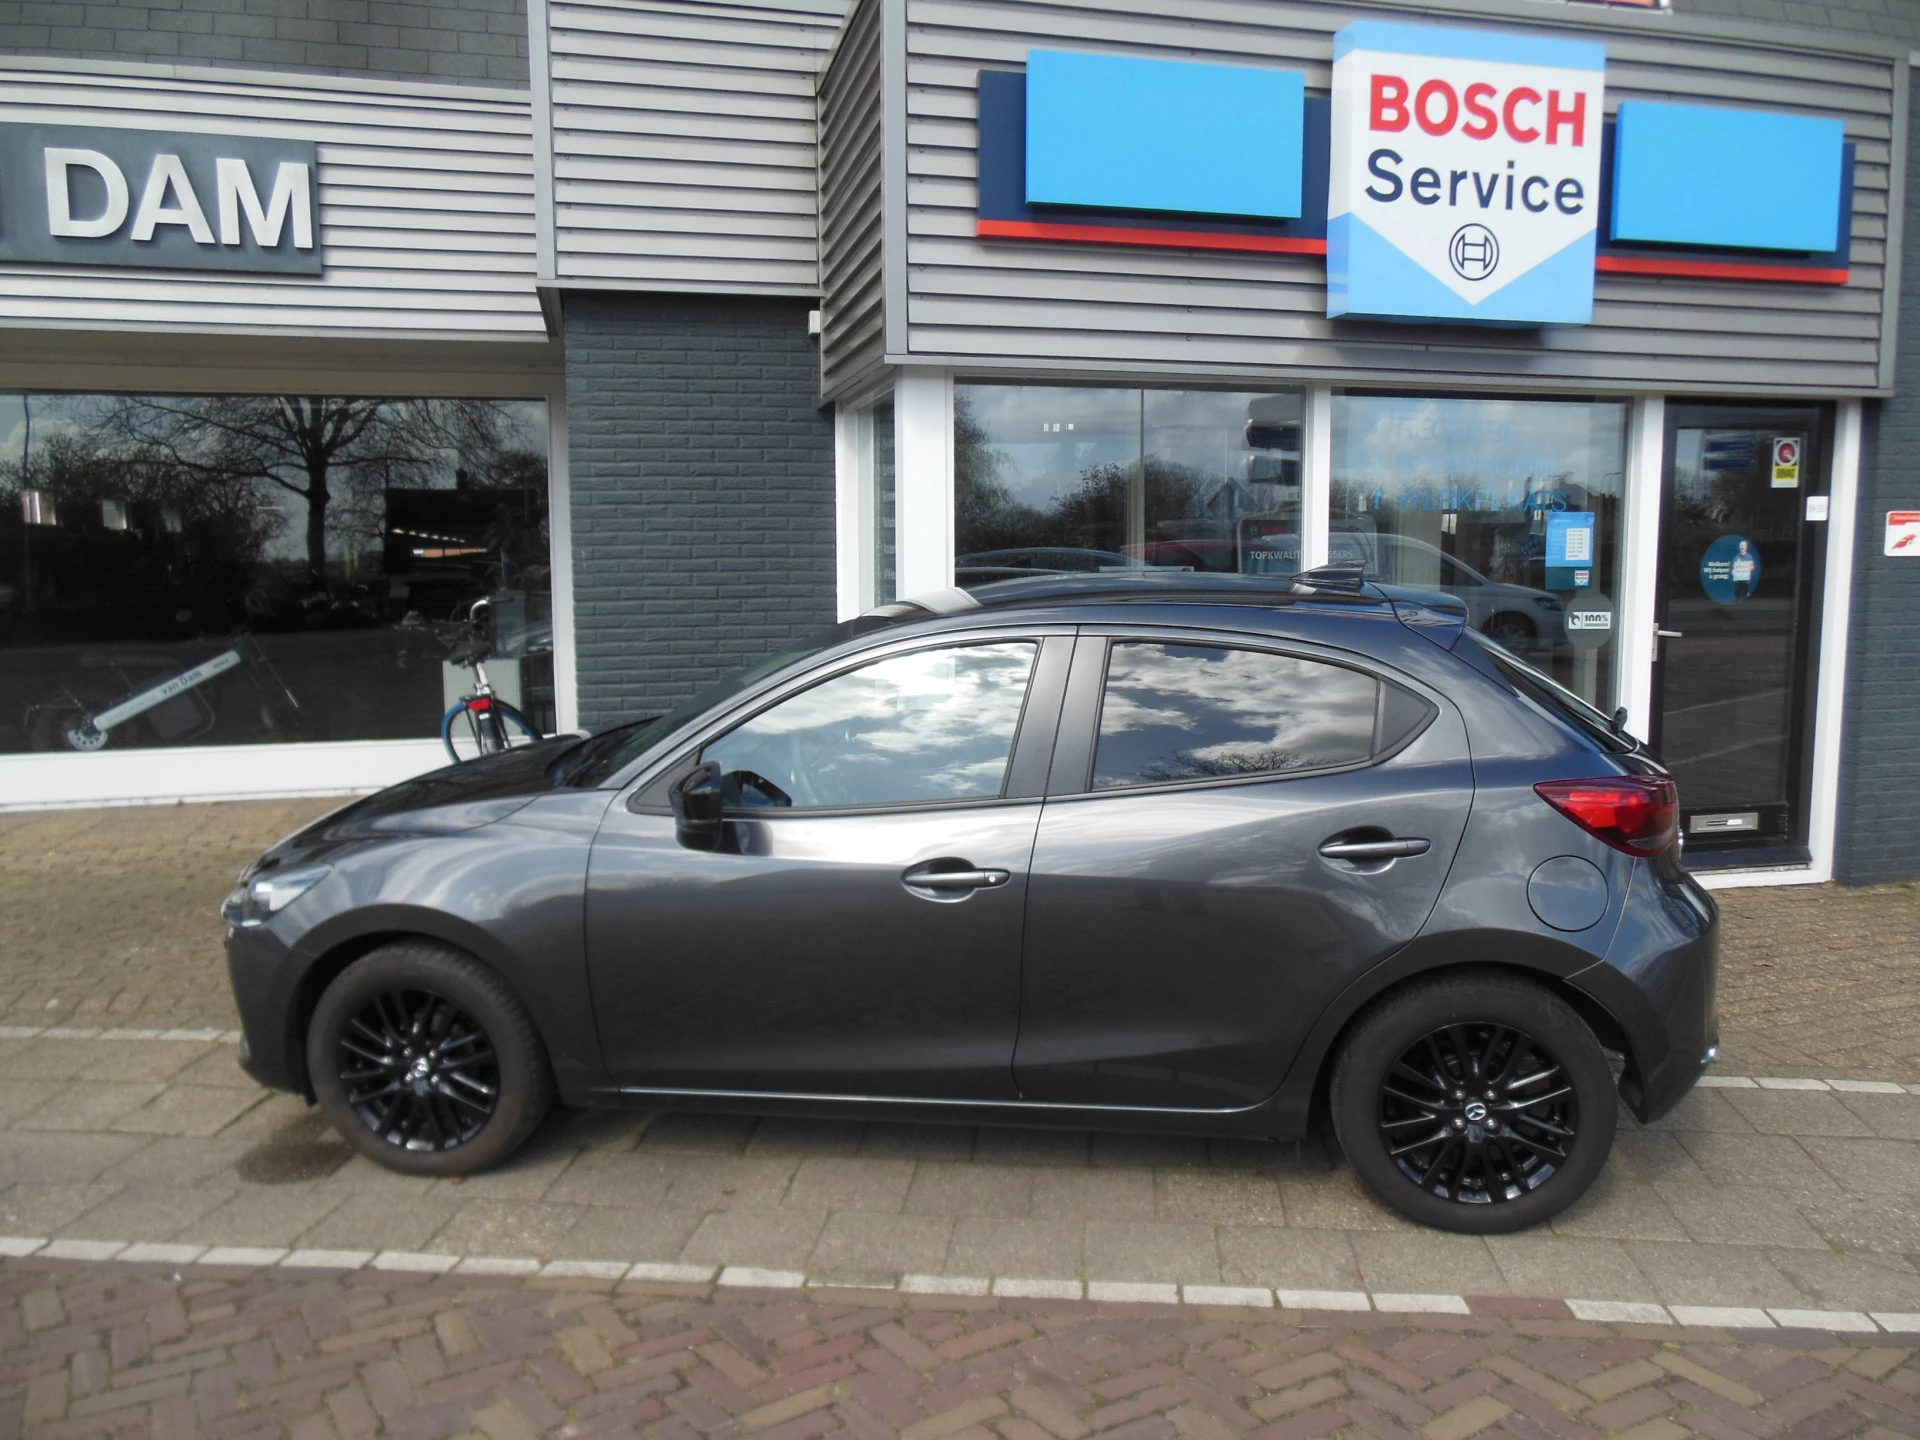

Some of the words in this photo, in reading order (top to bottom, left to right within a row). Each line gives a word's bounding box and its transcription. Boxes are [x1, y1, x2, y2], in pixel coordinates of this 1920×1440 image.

[1369, 73, 1586, 147] BOSCH
[43, 146, 314, 250] DAM
[1364, 148, 1585, 215] Service
[1398, 486, 1568, 512] WERKPLAATS
[1250, 551, 1300, 560] TOPKWALIT
[1328, 550, 1353, 559] SSERS
[160, 683, 179, 695] van
[179, 671, 203, 685] Dam
